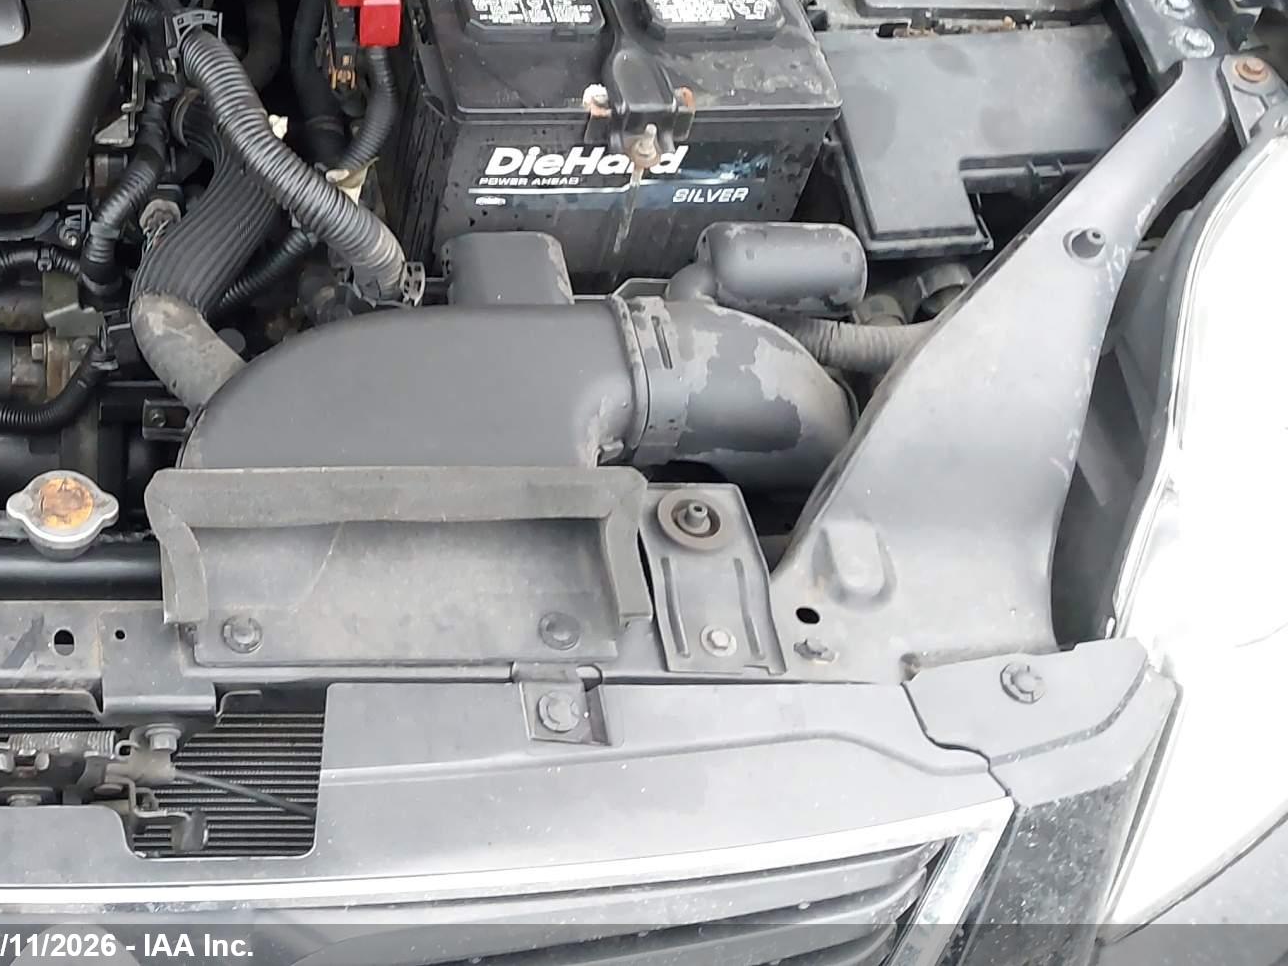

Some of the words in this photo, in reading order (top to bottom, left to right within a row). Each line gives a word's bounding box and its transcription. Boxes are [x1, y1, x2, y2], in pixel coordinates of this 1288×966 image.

[484, 145, 689, 176] DieHad
[478, 177, 529, 186] POWER
[530, 176, 580, 186] AHEAD
[672, 186, 750, 203] SILVER
